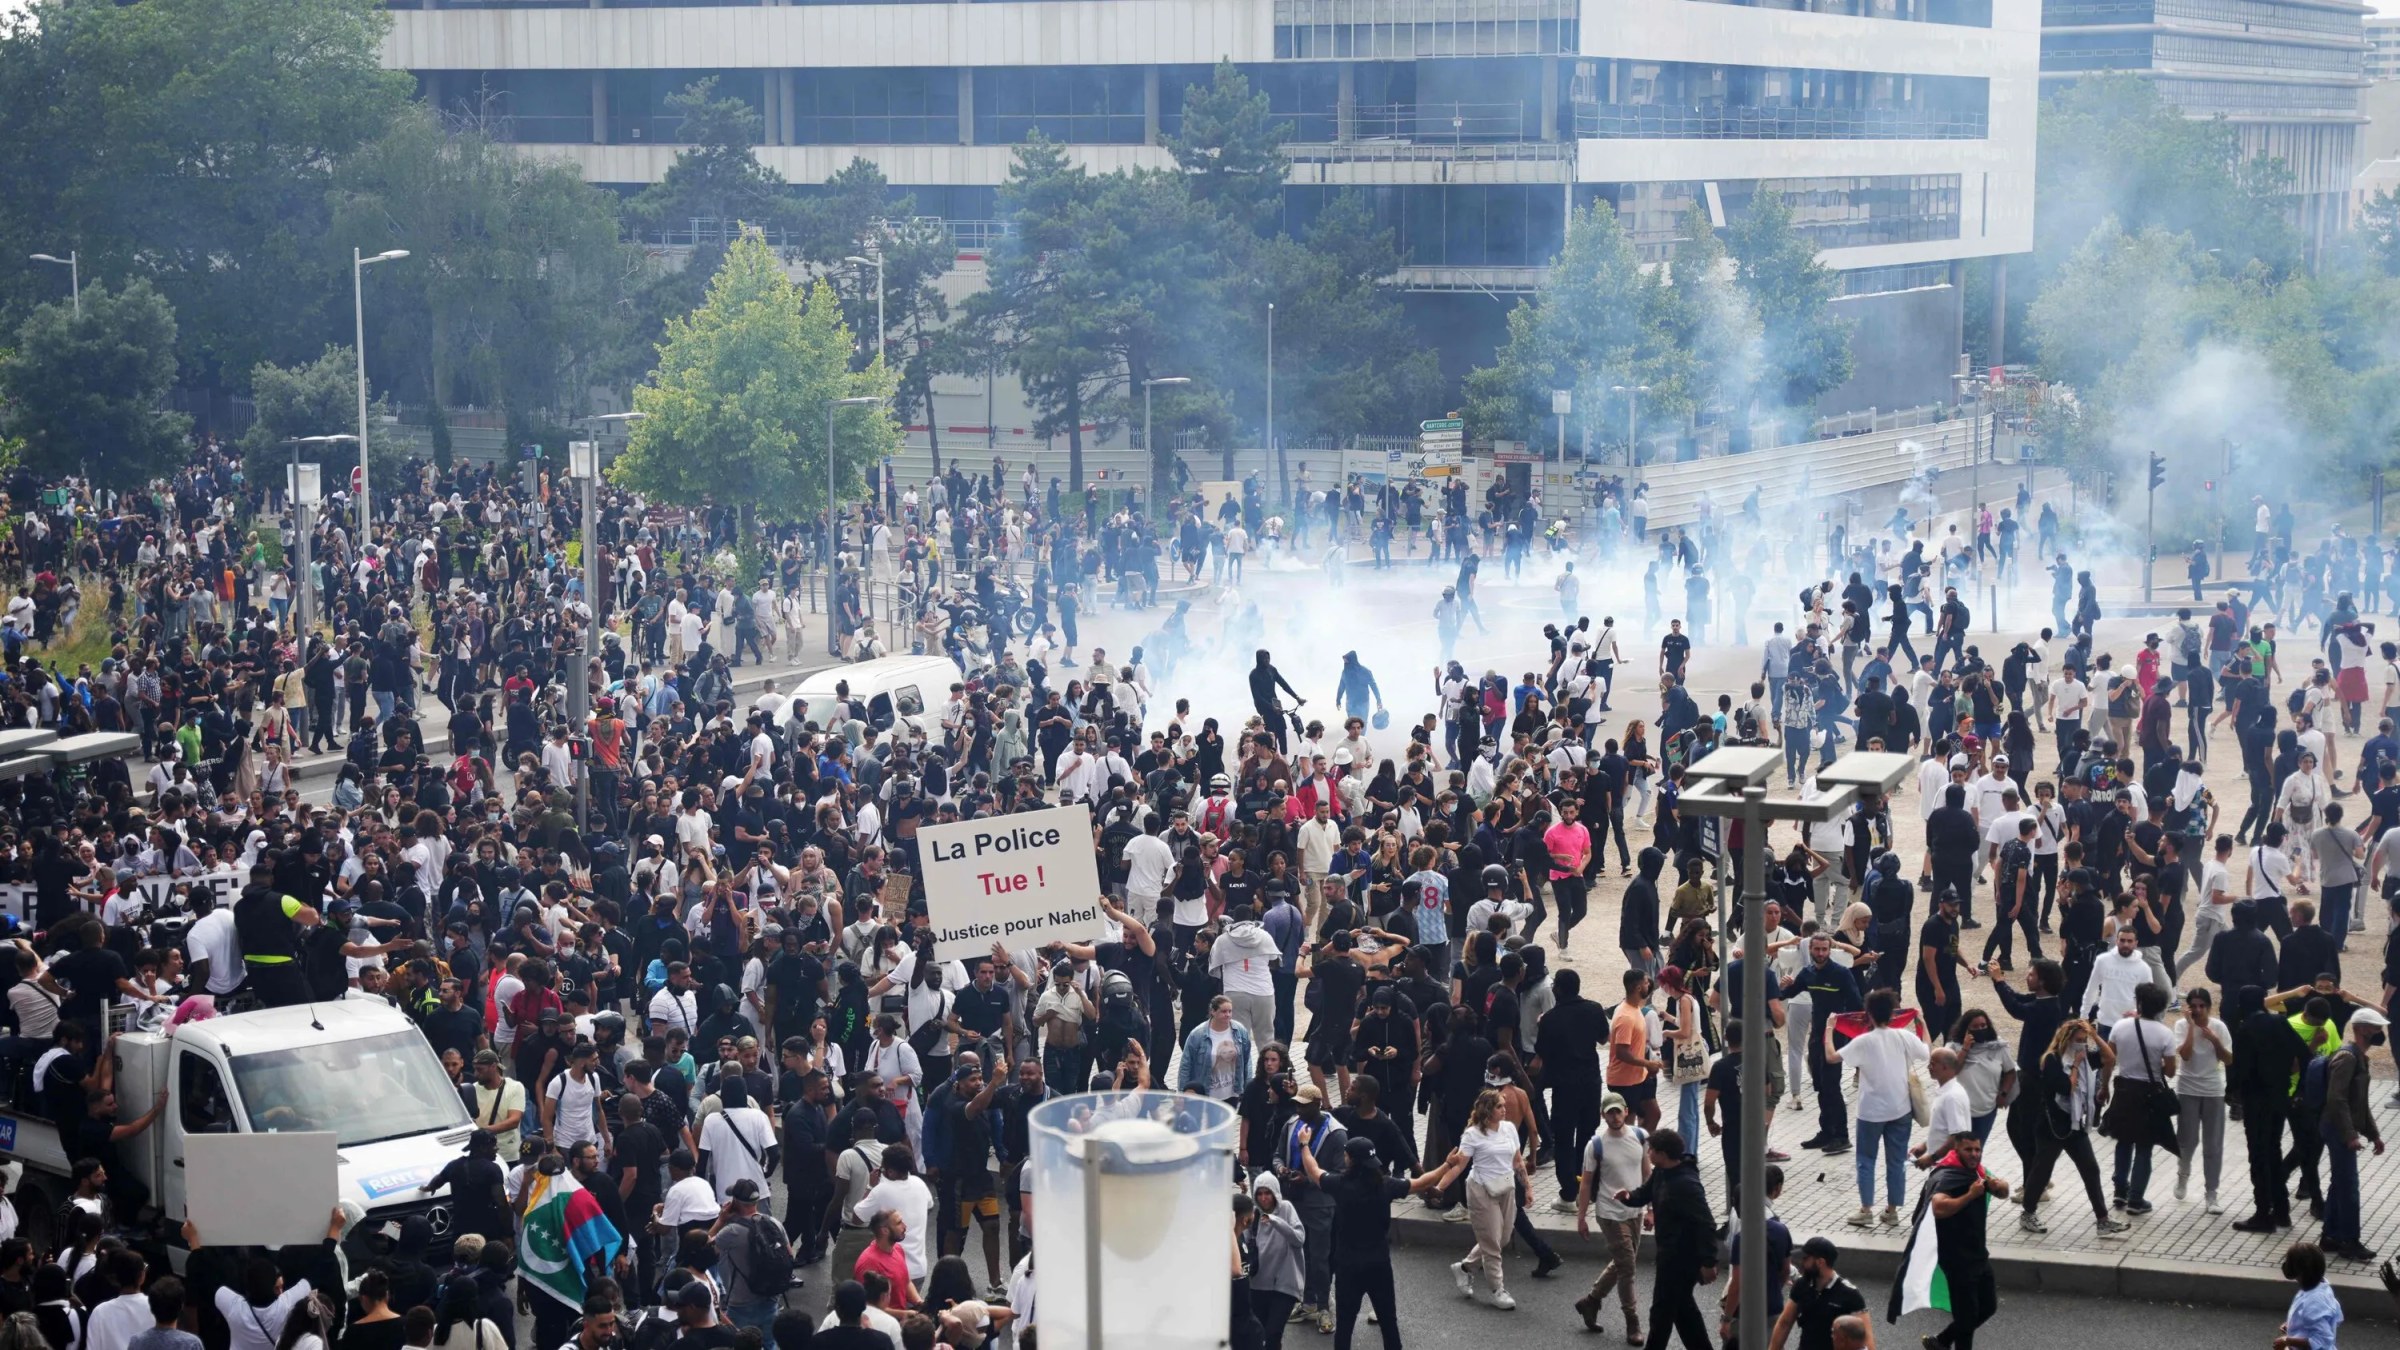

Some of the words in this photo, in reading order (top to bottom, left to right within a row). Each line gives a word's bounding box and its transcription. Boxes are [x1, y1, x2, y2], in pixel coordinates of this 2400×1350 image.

[932, 840, 966, 862] La
[974, 828, 1060, 856] Police
[977, 873, 1028, 896] Tue
[1037, 865, 1045, 887] !
[1424, 886, 1439, 909] 8
[938, 923, 999, 943] Justice
[1004, 916, 1043, 936] pour
[1049, 906, 1097, 926] Nahel
[562, 982, 571, 991] FC
[0, 1125, 13, 1141] AR
[367, 1170, 415, 1191] RENT
